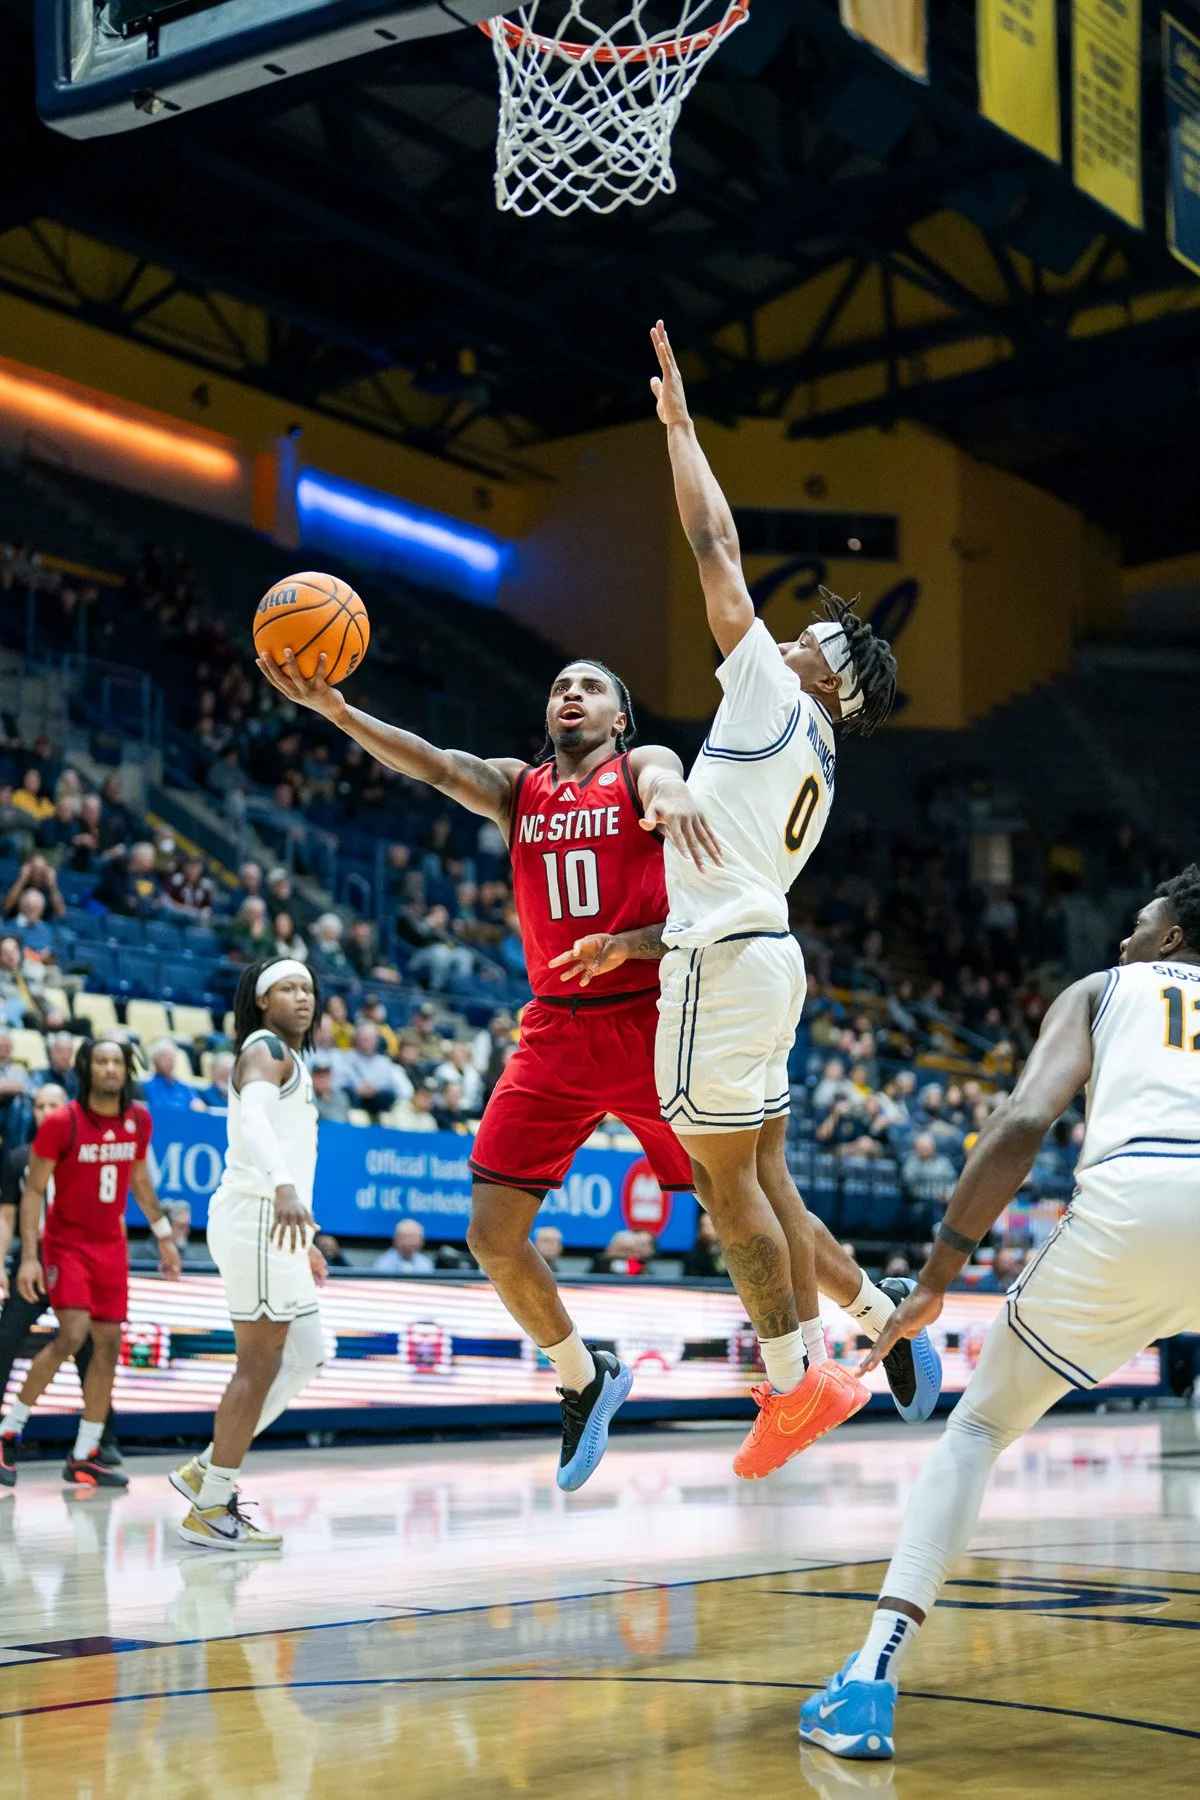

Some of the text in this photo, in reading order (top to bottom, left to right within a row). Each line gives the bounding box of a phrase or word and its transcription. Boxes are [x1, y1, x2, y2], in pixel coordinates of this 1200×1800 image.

[258, 588, 297, 613] Wil
[519, 806, 621, 843] NC STATE
[784, 773, 819, 854] 0
[542, 848, 600, 920] 10
[78, 1141, 137, 1163] NC STATE
[148, 1142, 223, 1193] MO
[365, 1147, 428, 1177] Official
[99, 1164, 118, 1203] 8
[356, 1180, 377, 1210] of
[407, 1186, 473, 1216] Berkele
[540, 1173, 612, 1217] MO
